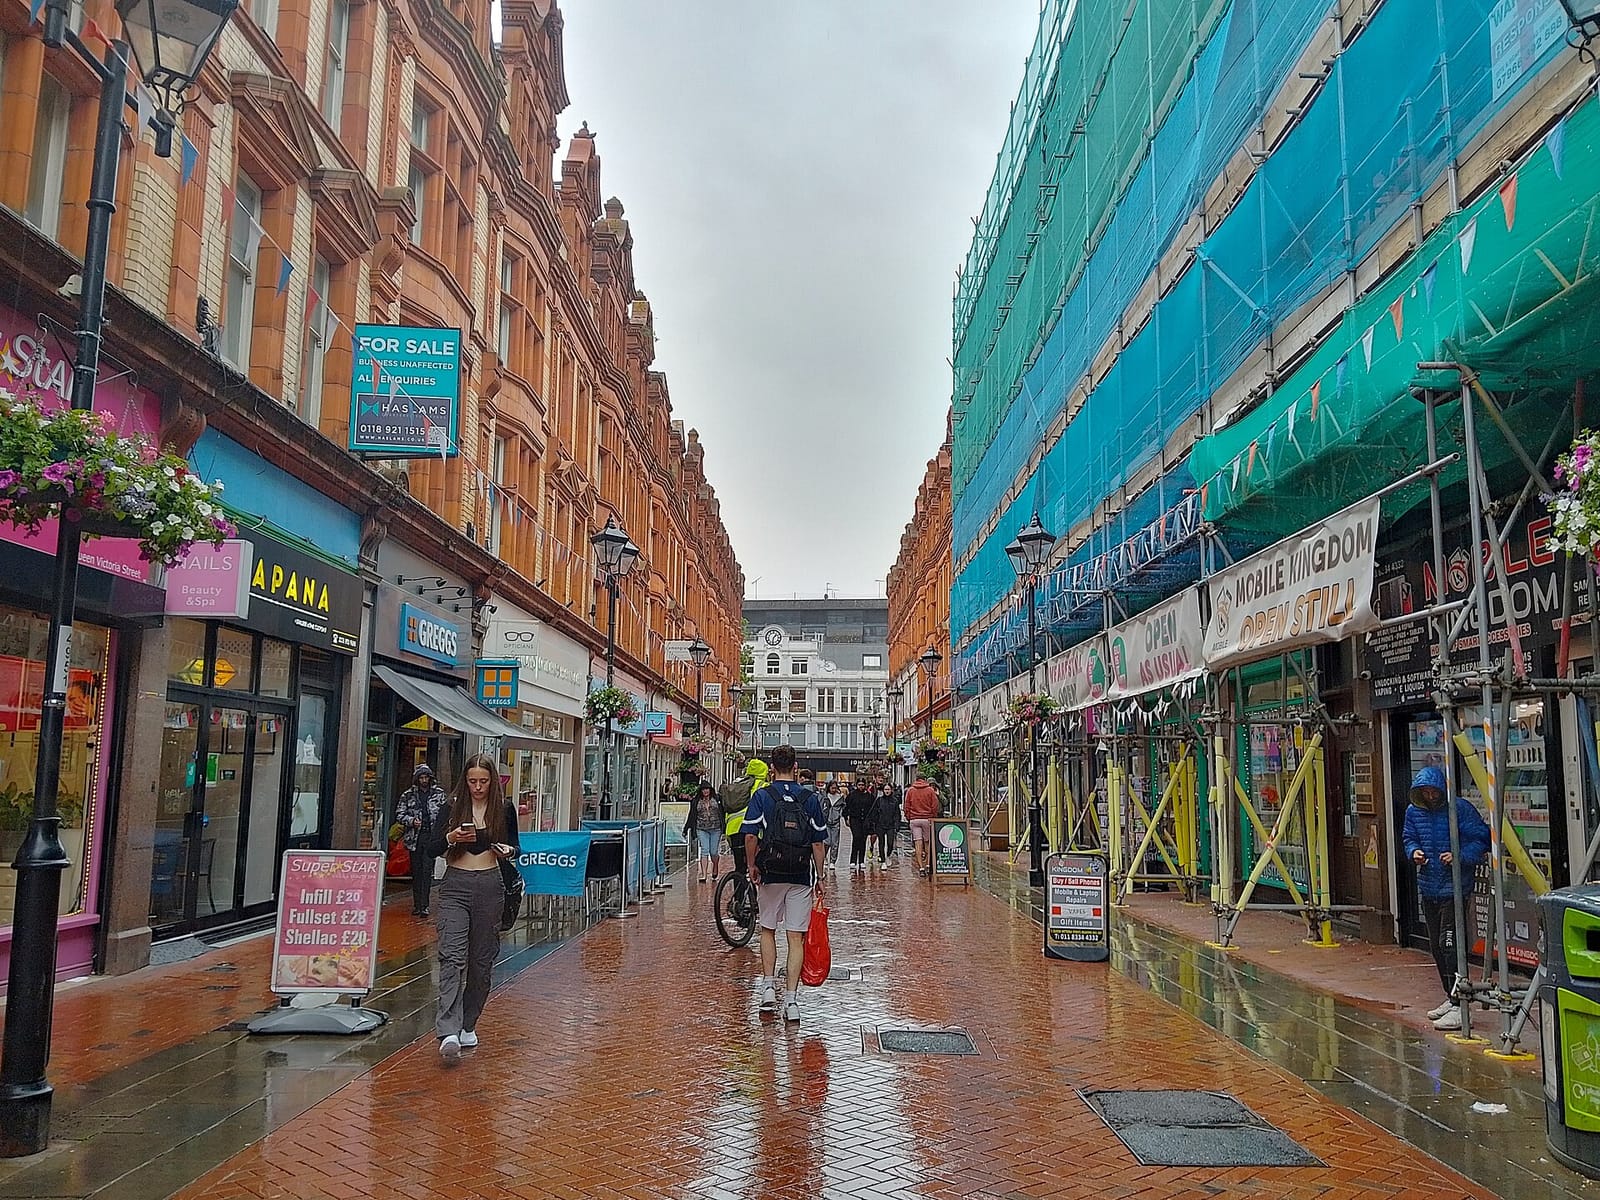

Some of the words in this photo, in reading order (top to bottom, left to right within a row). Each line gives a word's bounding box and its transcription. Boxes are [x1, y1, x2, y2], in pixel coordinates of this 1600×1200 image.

[360, 337, 400, 353] FOR
[406, 339, 455, 356] SALE
[13, 334, 75, 401] StA
[359, 358, 398, 368] BUSNESS
[400, 360, 454, 370] UNAFFECTED
[380, 375, 436, 386] ENQUIRIES
[360, 424, 382, 433] 0118
[385, 426, 401, 434] 921
[405, 427, 425, 435] 1515
[78, 553, 95, 565] ueen
[96, 556, 121, 572] Victoria
[122, 564, 141, 579] Street
[174, 556, 233, 571] NAILS
[1236, 558, 1285, 608] MOBILE
[1288, 518, 1372, 587] KINGDOM
[181, 585, 222, 596] Beauty
[185, 597, 216, 607] &Spa
[1145, 609, 1177, 653] OPEN
[1238, 600, 1290, 652] OPEN
[418, 619, 458, 657] GREGGS
[1140, 659, 1154, 687] AS
[1374, 686, 1392, 697] VAPING
[1399, 684, 1403, 694] E
[1404, 680, 1425, 692] LIQUIDS
[751, 693, 793, 704] JOHN
[747, 712, 796, 723] LEWIS
[291, 858, 338, 876] Super
[341, 860, 377, 873] StAR
[518, 852, 577, 868] GREGGS
[300, 888, 332, 905] Infill
[335, 889, 361, 905] £20
[1054, 888, 1073, 896] Mobile
[1079, 889, 1099, 898] Laptop
[289, 908, 337, 925] Fullset
[340, 910, 367, 925] £28
[285, 929, 338, 946] Shellac
[340, 930, 367, 946] £20
